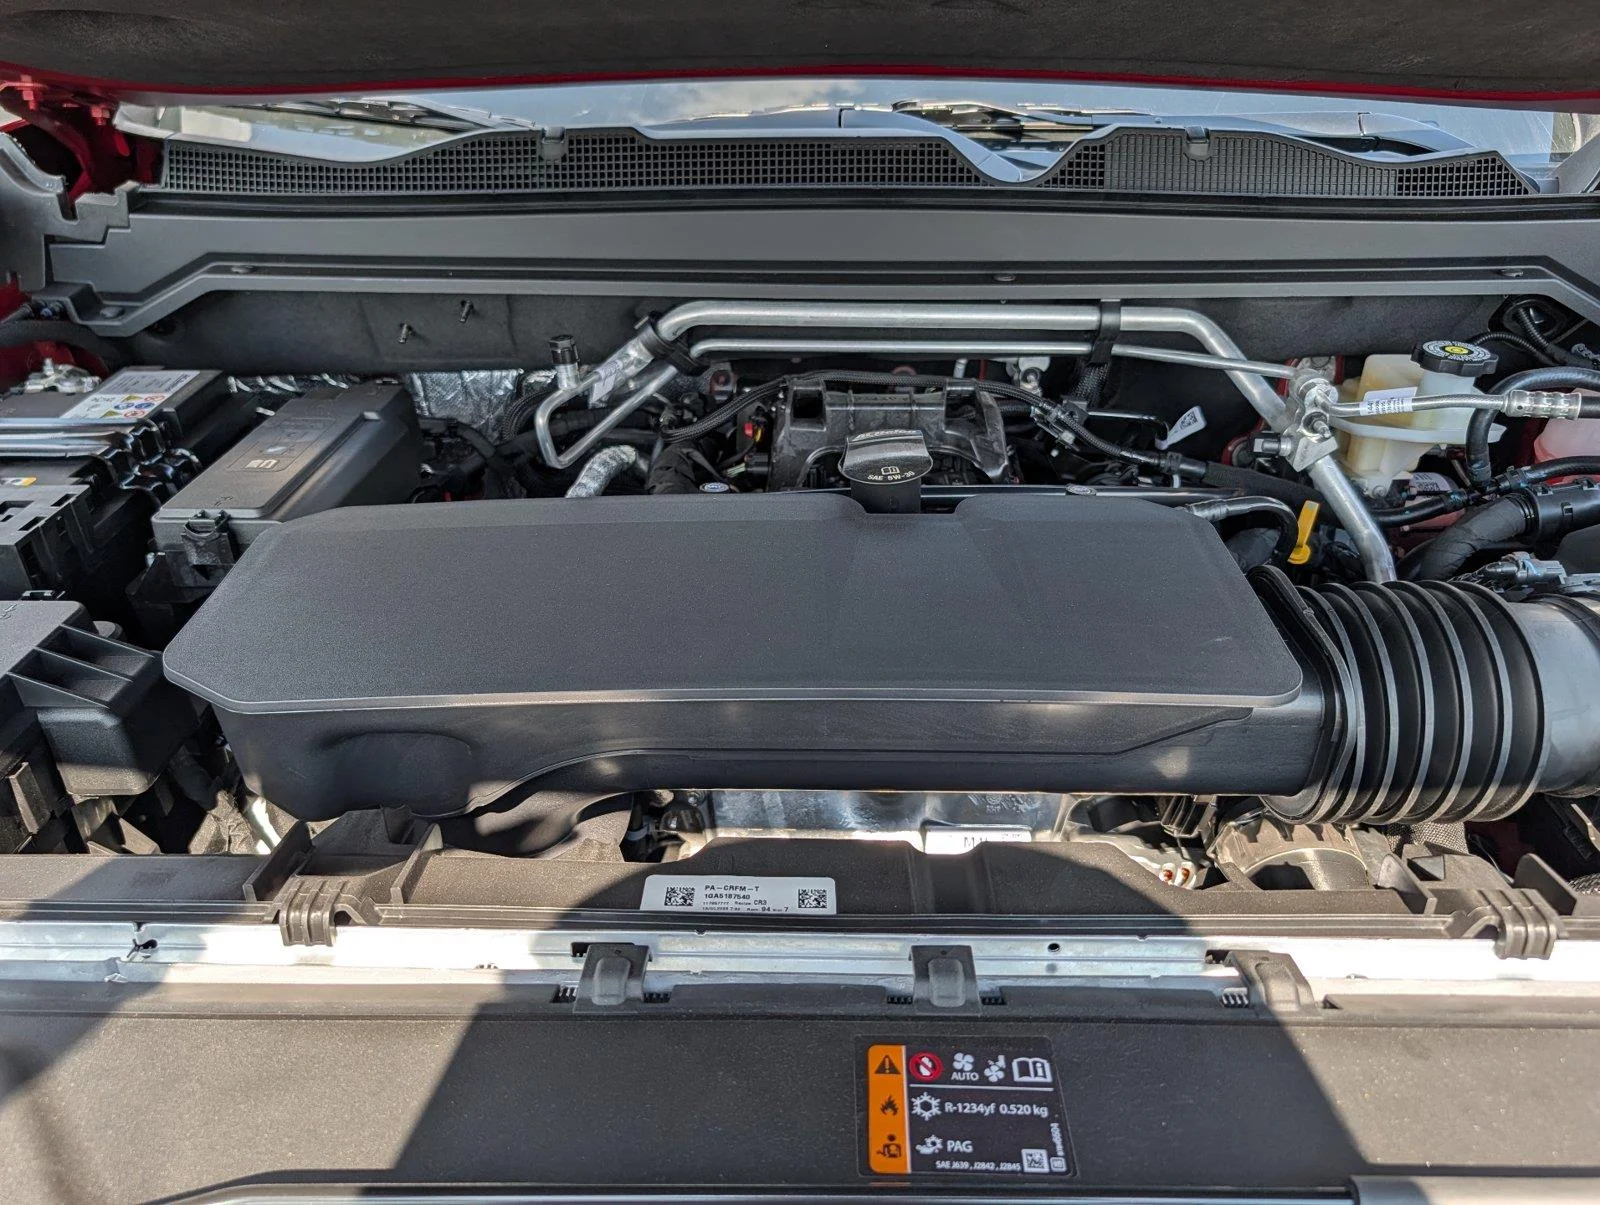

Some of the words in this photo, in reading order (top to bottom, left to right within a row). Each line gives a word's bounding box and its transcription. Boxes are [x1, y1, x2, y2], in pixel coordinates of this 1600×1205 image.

[951, 1072, 979, 1081] AUTO
[944, 1102, 995, 1117] R-1234yf
[999, 1103, 1032, 1116] 0.520
[1032, 1104, 1048, 1118] kg
[947, 1139, 973, 1153] PAG
[935, 1160, 951, 1169] SAE
